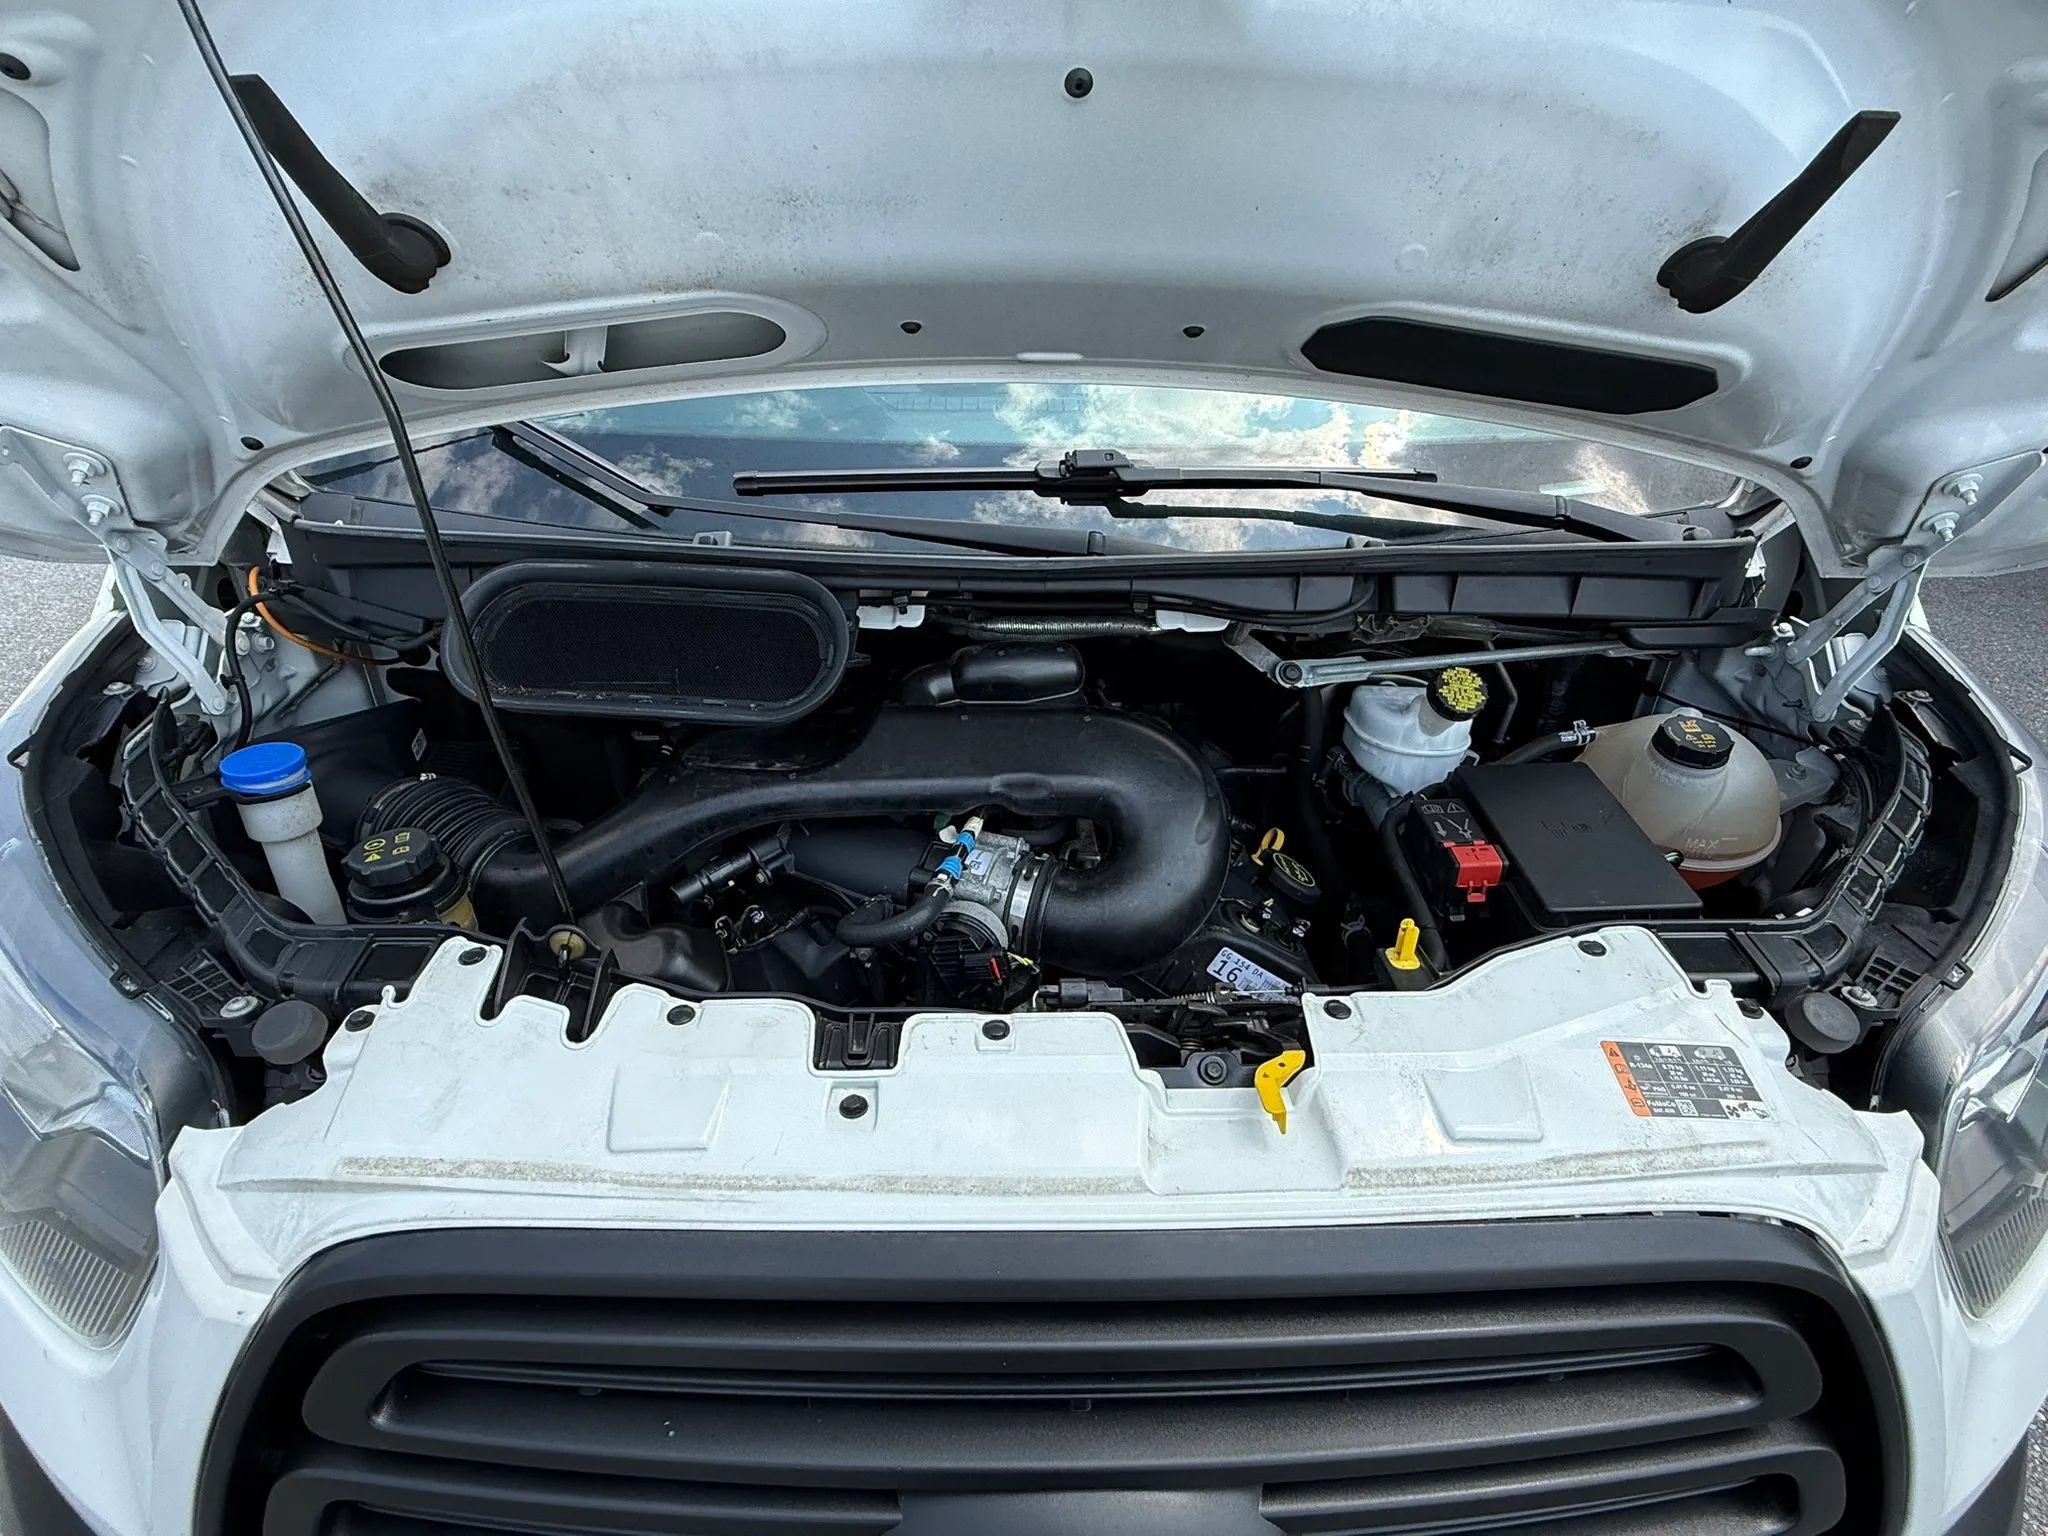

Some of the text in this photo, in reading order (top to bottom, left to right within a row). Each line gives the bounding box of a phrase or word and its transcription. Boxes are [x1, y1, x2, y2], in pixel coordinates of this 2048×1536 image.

[1685, 838, 1719, 849] MAX
[1212, 959, 1243, 983] 16
[1220, 949, 1232, 960] GG
[1251, 966, 1264, 979] DA
